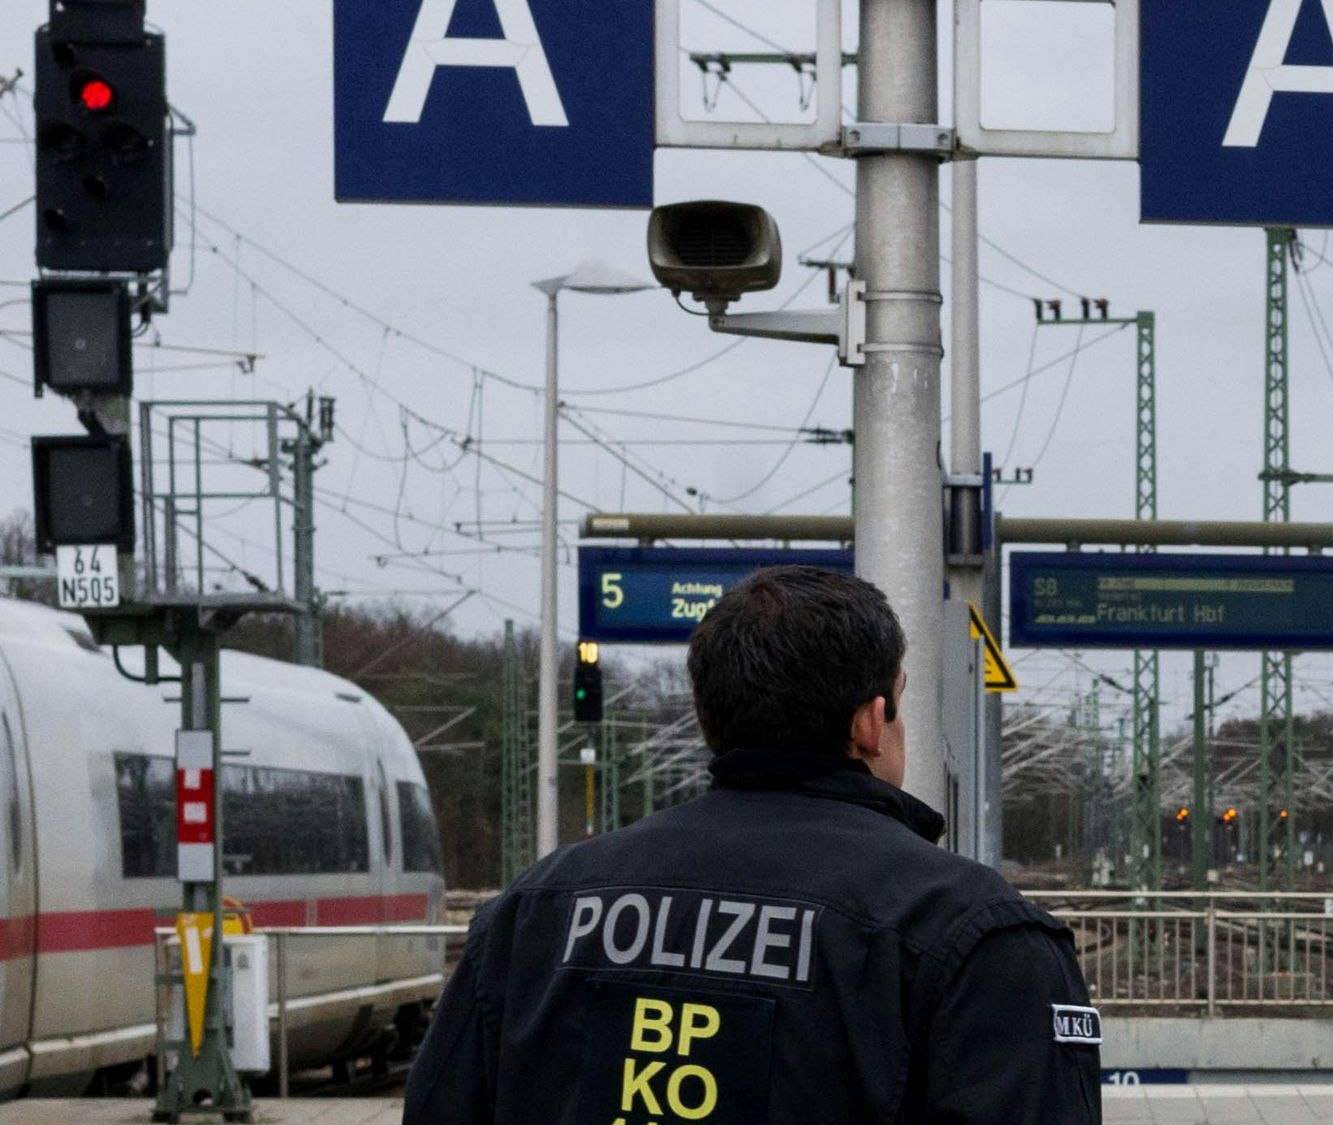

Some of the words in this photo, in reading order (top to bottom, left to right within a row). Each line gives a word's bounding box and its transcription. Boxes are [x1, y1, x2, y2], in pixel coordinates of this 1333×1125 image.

[384, 0, 568, 126] A
[62, 577, 115, 603] N505
[602, 573, 624, 609] 5
[1096, 603, 1185, 623] Frankfurt
[1194, 604, 1226, 624] Hbf
[563, 892, 815, 981] POLIZEI
[630, 998, 720, 1056] BP
[1056, 1013, 1093, 1037] MKÜ
[619, 1058, 718, 1120] KO
